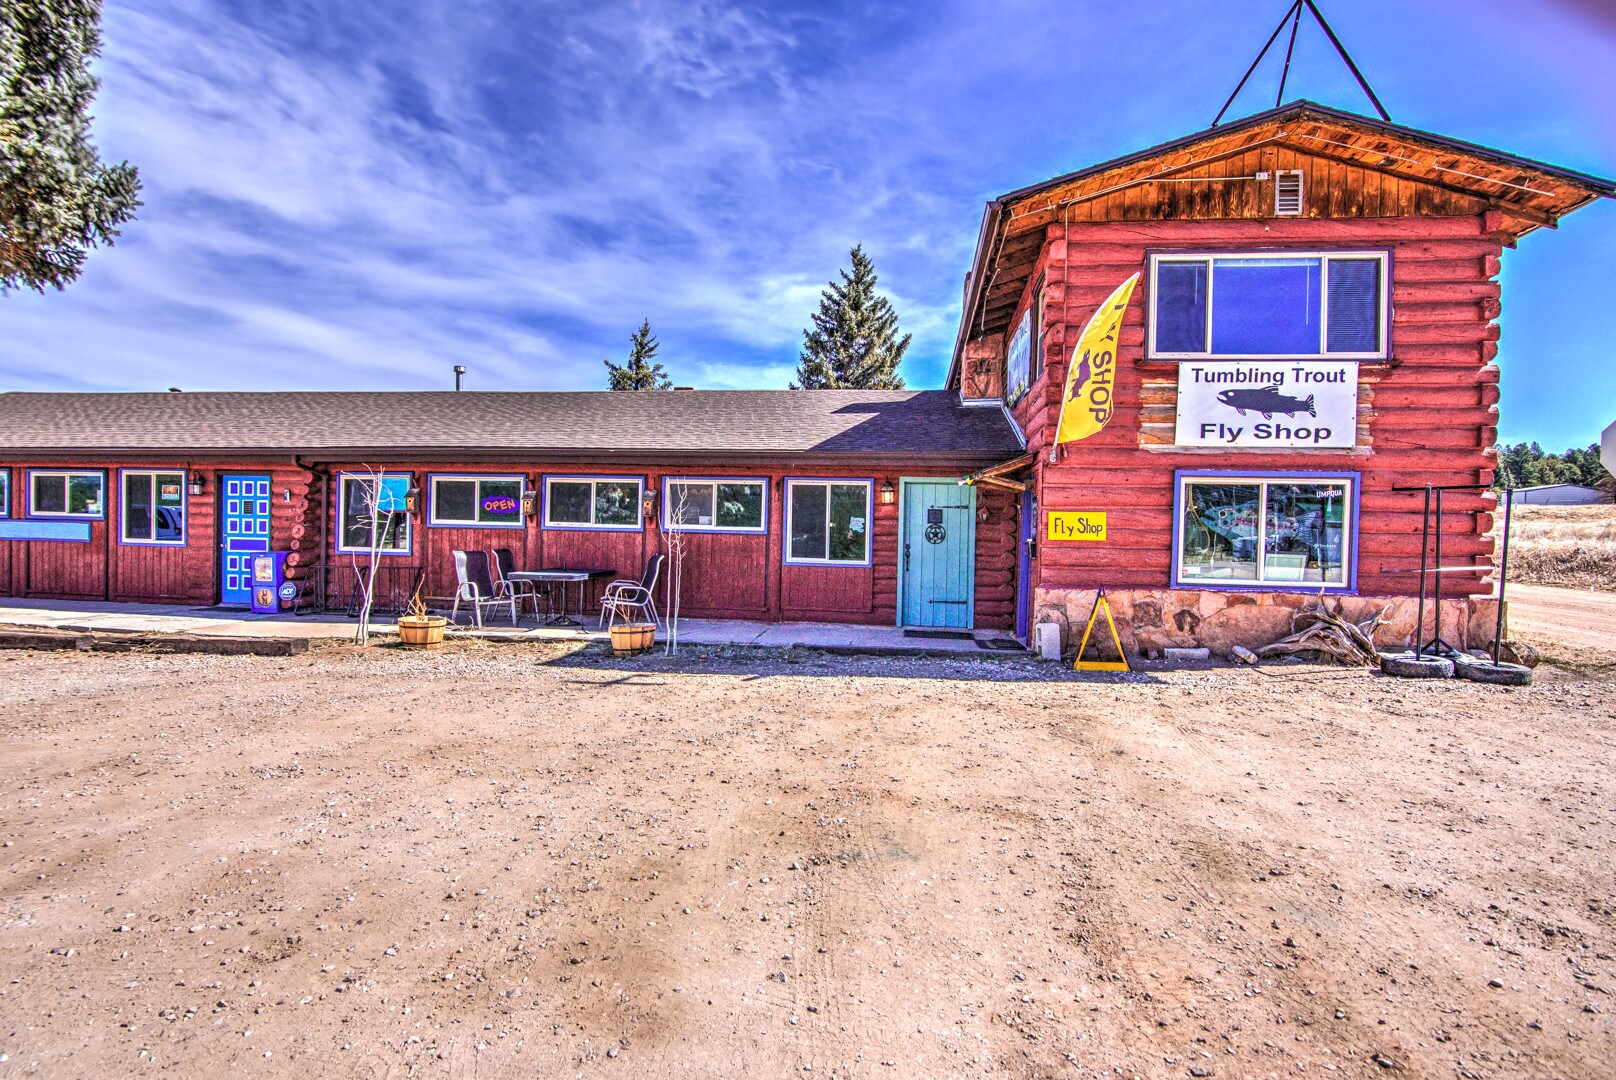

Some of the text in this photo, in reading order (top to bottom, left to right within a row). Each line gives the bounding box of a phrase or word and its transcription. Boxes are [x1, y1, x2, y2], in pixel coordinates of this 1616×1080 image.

[1191, 367, 1346, 386] Tumbling Trout
[1089, 350, 1113, 423] SHOP
[1200, 423, 1332, 443] Fly Shop
[1316, 489, 1342, 498] UMPQUA
[484, 499, 516, 511] OPEN
[1053, 516, 1103, 537] Fly Shop
